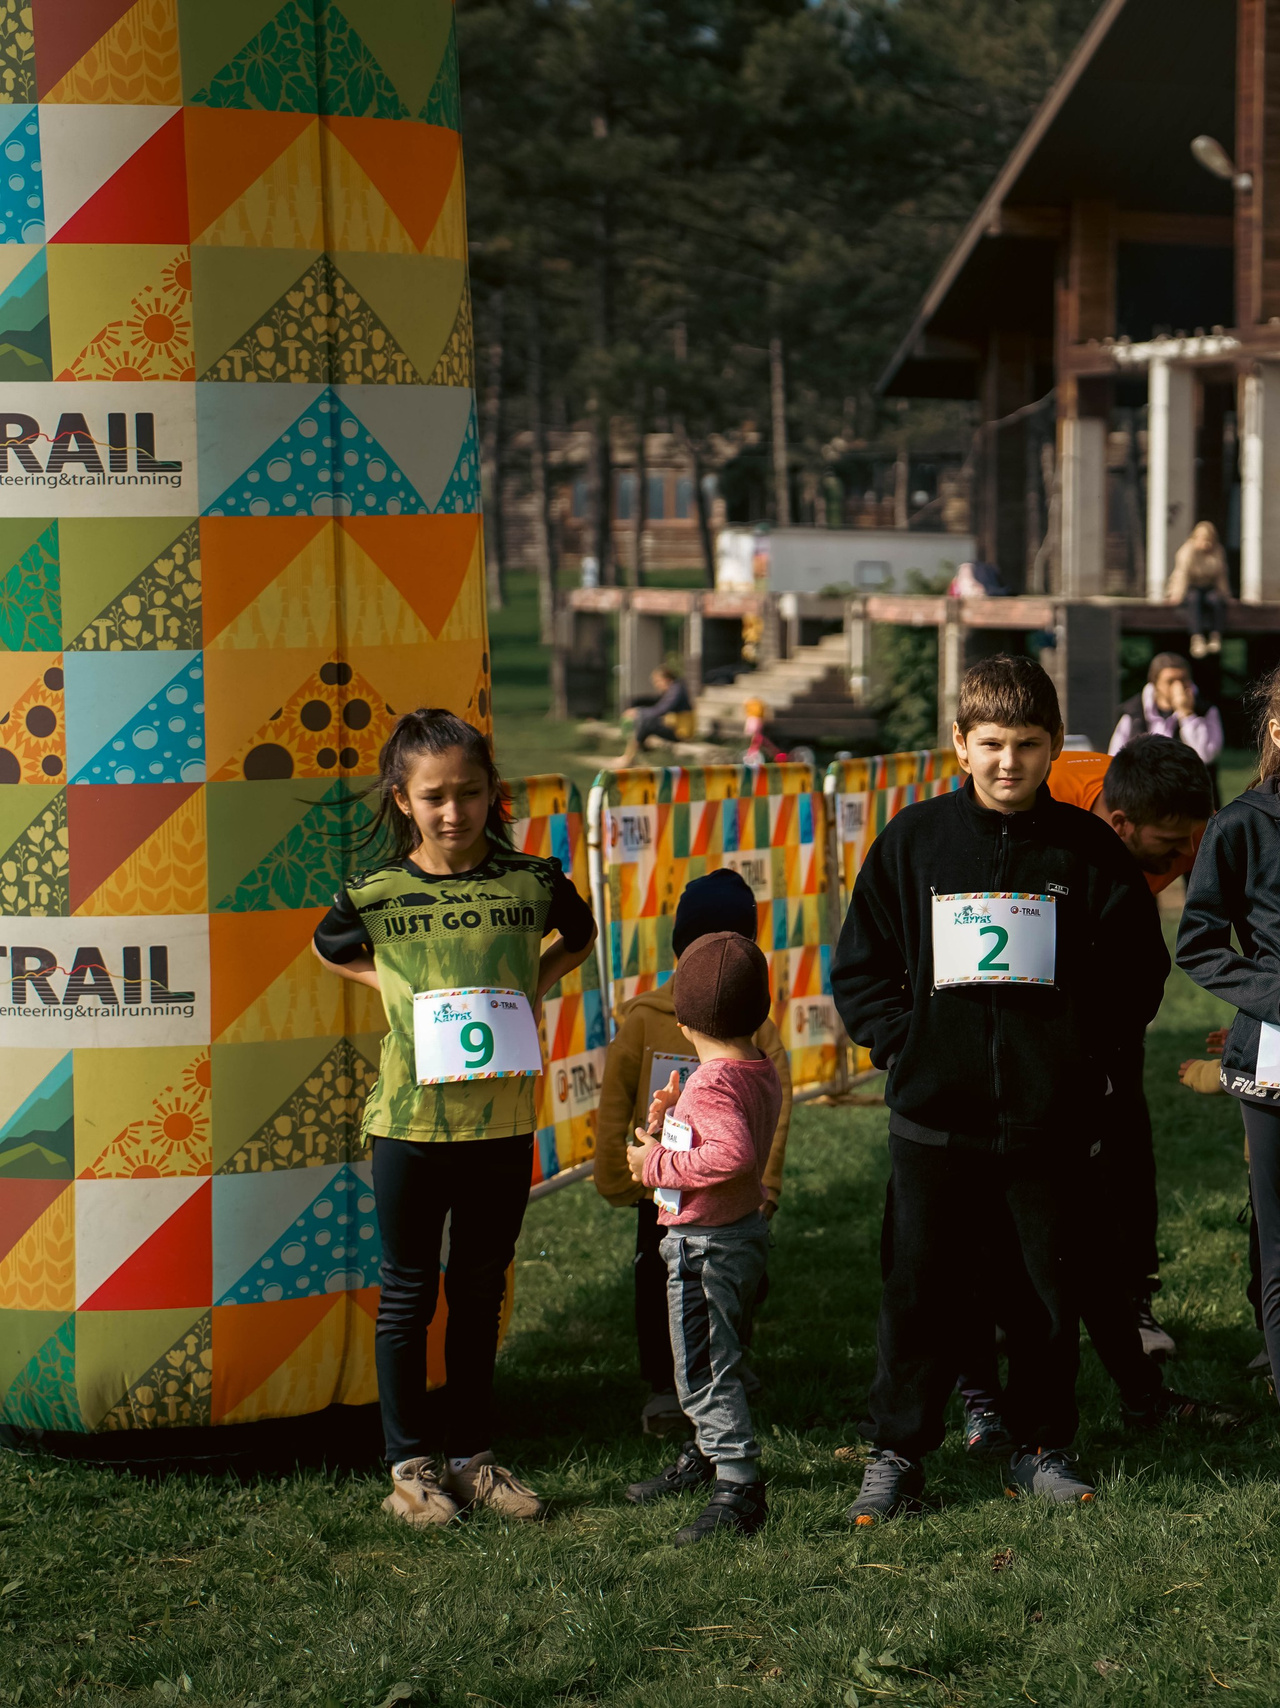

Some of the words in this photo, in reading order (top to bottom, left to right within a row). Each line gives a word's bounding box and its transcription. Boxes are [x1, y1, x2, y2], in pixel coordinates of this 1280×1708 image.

[384, 914, 433, 937] JUST
[442, 910, 482, 930] GO
[490, 907, 535, 926] RUN
[978, 925, 1009, 971] 2
[0, 945, 195, 1005] RAIL
[460, 1021, 494, 1069] 9
